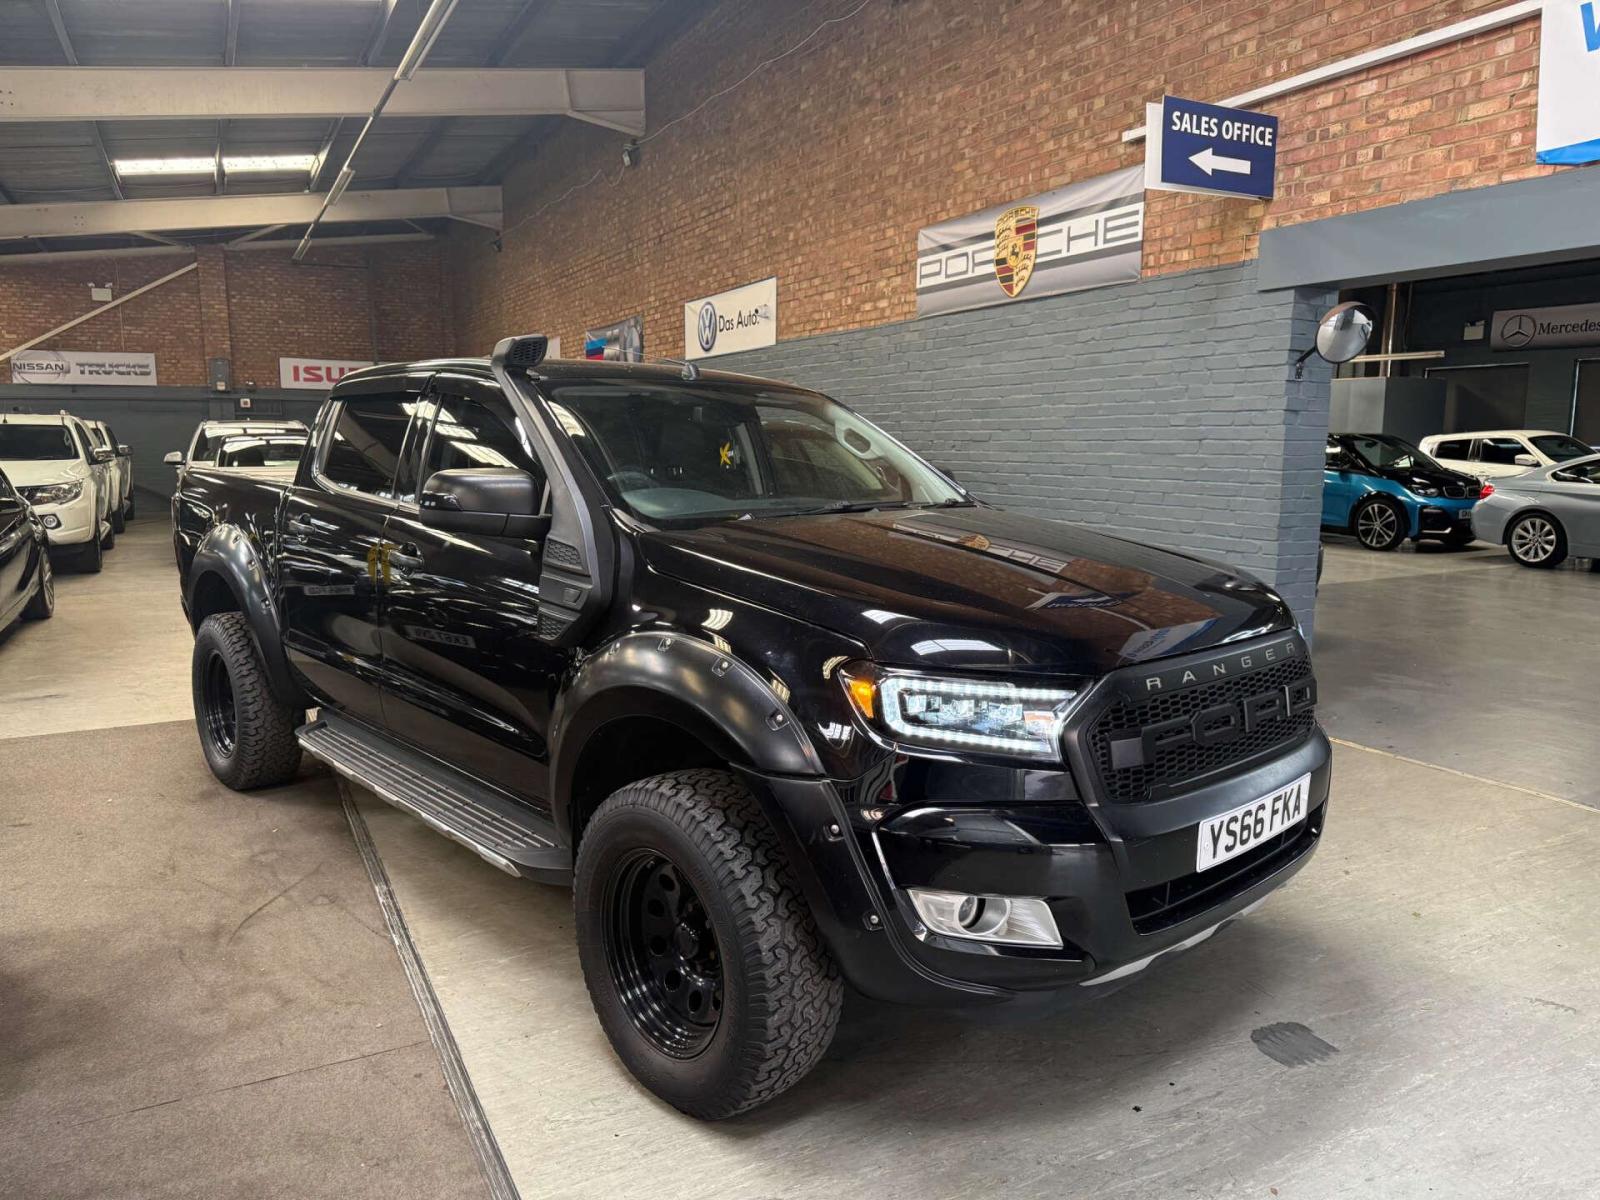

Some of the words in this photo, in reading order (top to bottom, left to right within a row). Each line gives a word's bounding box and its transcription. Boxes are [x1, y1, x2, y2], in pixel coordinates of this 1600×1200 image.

[1171, 111, 1218, 138] SALES
[1221, 120, 1273, 147] OFFICE
[919, 209, 1140, 285] PORCHE
[718, 315, 735, 333] Das
[12, 362, 65, 372] NISSAN
[75, 362, 152, 376] TRUCKS
[292, 365, 361, 383] ISU
[1146, 642, 1297, 692] RANGER
[1210, 803, 1266, 860] YS66
[1269, 784, 1302, 832] FKA
